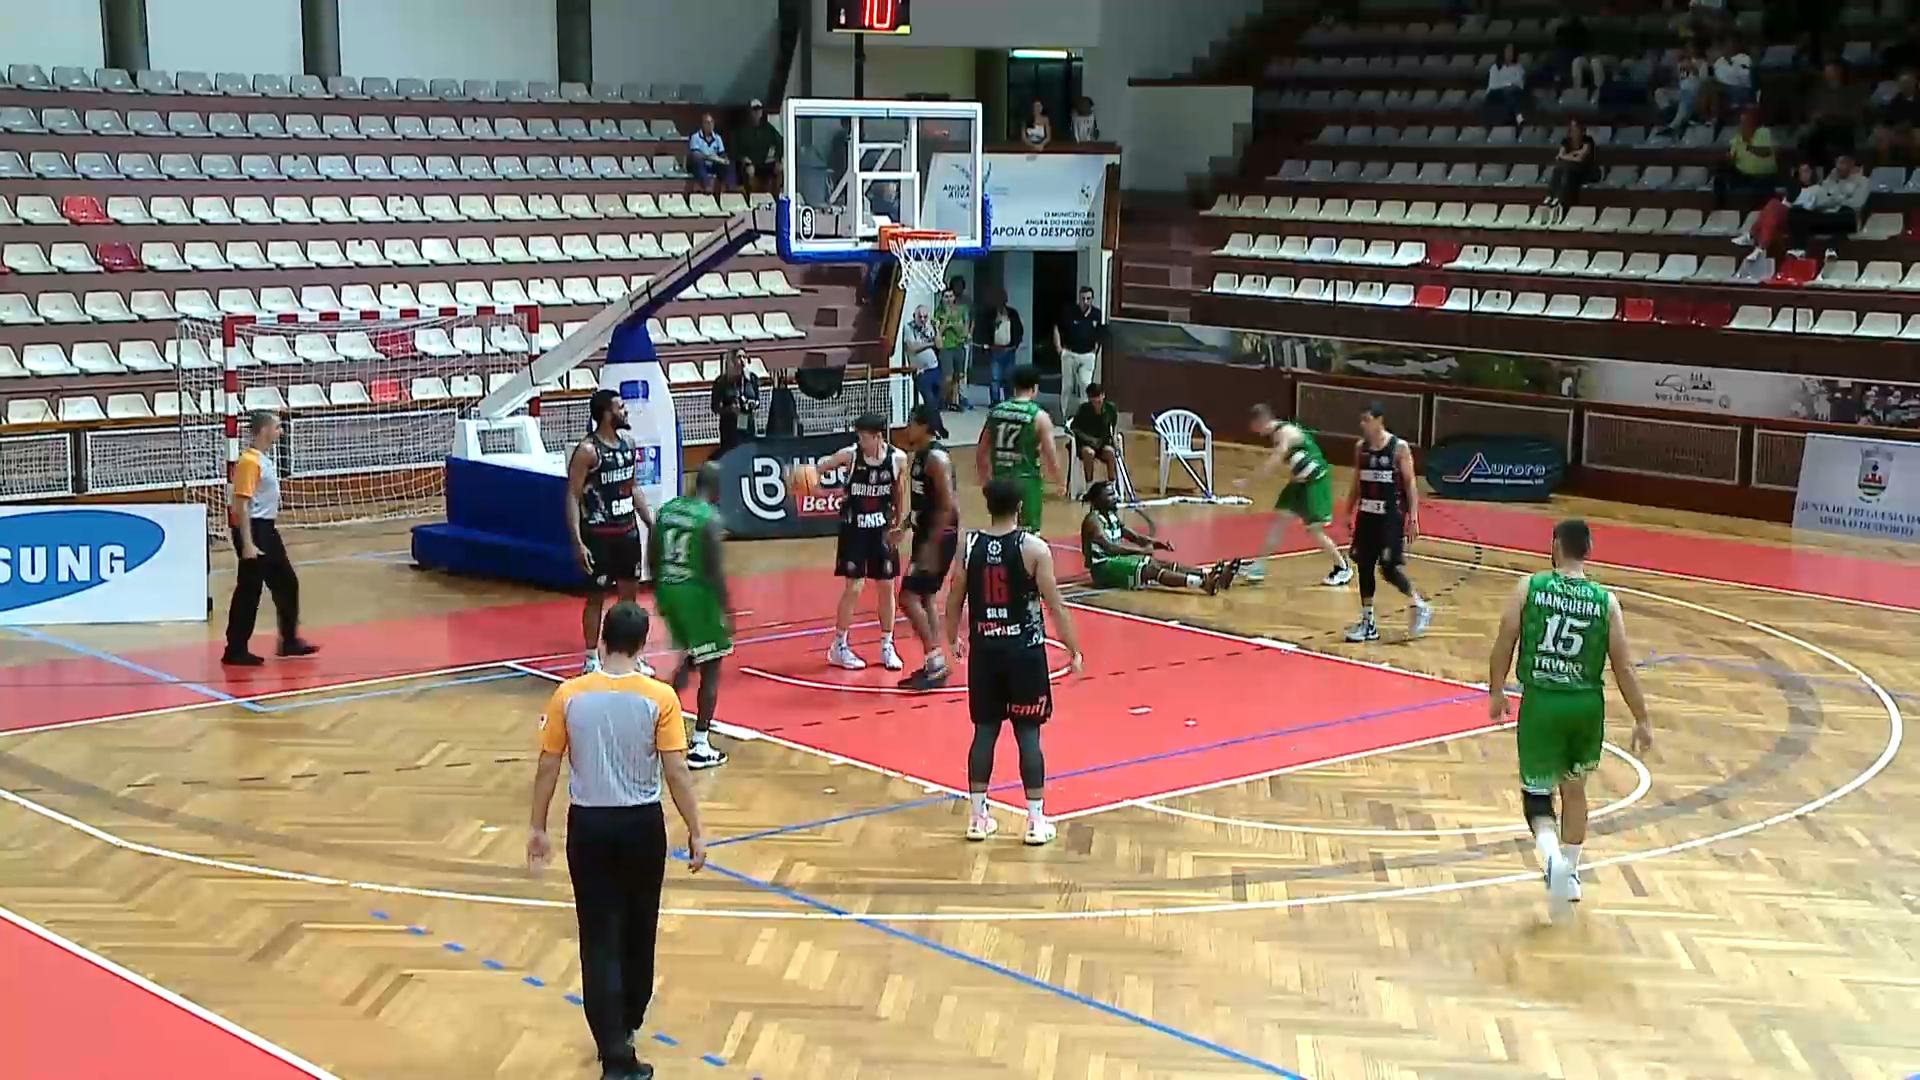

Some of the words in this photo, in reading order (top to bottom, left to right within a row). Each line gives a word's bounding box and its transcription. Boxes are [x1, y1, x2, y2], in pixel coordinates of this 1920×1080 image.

[992, 227, 1025, 238] APOIA
[1028, 227, 1038, 237] O
[1041, 227, 1095, 238] DESPORTO
[996, 421, 1022, 448] 17
[1534, 591, 1601, 617] MANGUEIRA
[1537, 613, 1592, 659] 15
